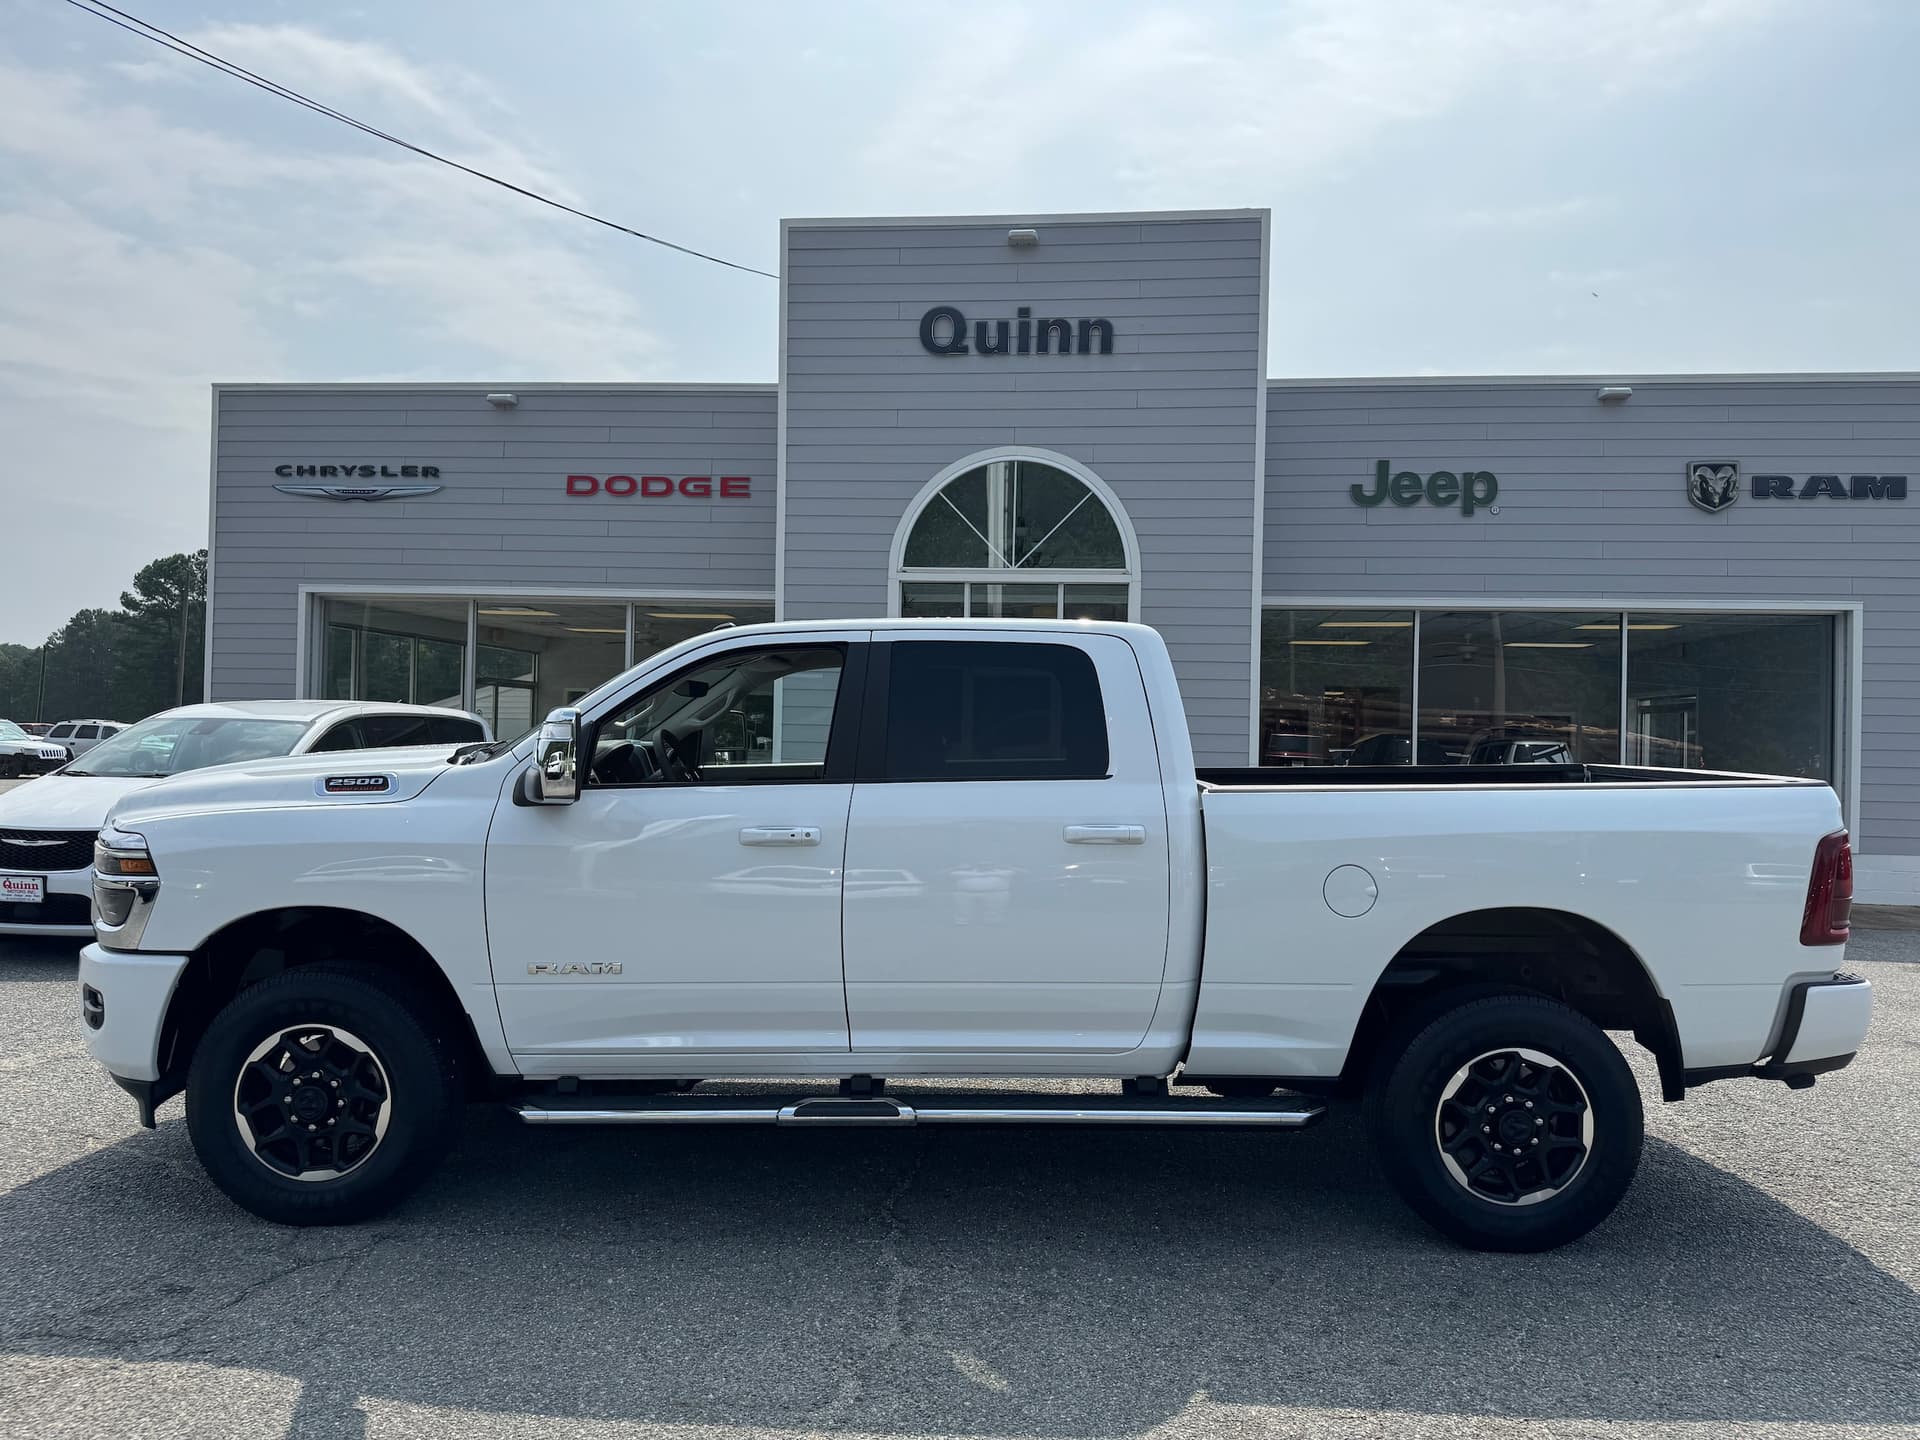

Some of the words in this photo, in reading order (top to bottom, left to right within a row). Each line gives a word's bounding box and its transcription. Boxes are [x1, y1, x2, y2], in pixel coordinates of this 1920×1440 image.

[919, 306, 1114, 355] Quinn
[274, 464, 441, 479] CHRYSLER
[566, 475, 752, 499] DODGE
[1350, 459, 1499, 518] Jeep
[1751, 475, 1908, 500] RAM
[328, 777, 384, 786] 2500
[3, 880, 39, 890] Quinn
[527, 961, 623, 976] RAM
